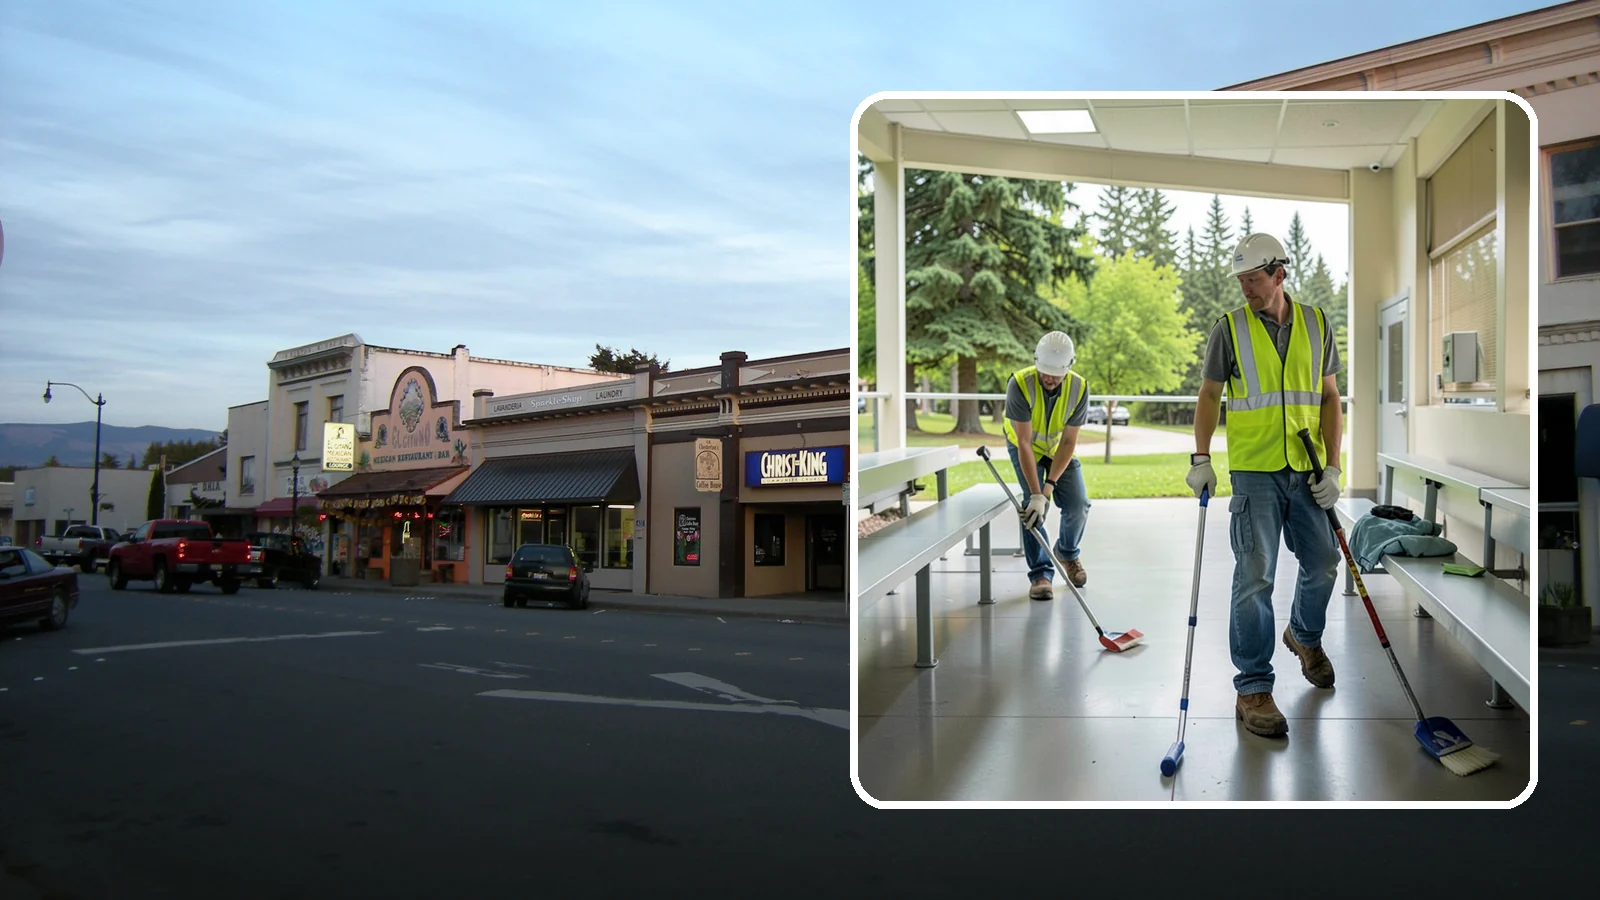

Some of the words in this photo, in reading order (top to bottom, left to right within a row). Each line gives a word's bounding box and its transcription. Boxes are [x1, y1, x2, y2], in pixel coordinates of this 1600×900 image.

[596, 389, 623, 399] LAUNDRY
[494, 402, 522, 412] LAVANDERIA
[373, 455, 396, 464] MEXICAN
[397, 452, 433, 462] RESTAURANT
[438, 450, 450, 459] BAR
[761, 452, 797, 477] CHRIST
[799, 450, 827, 476] KING
